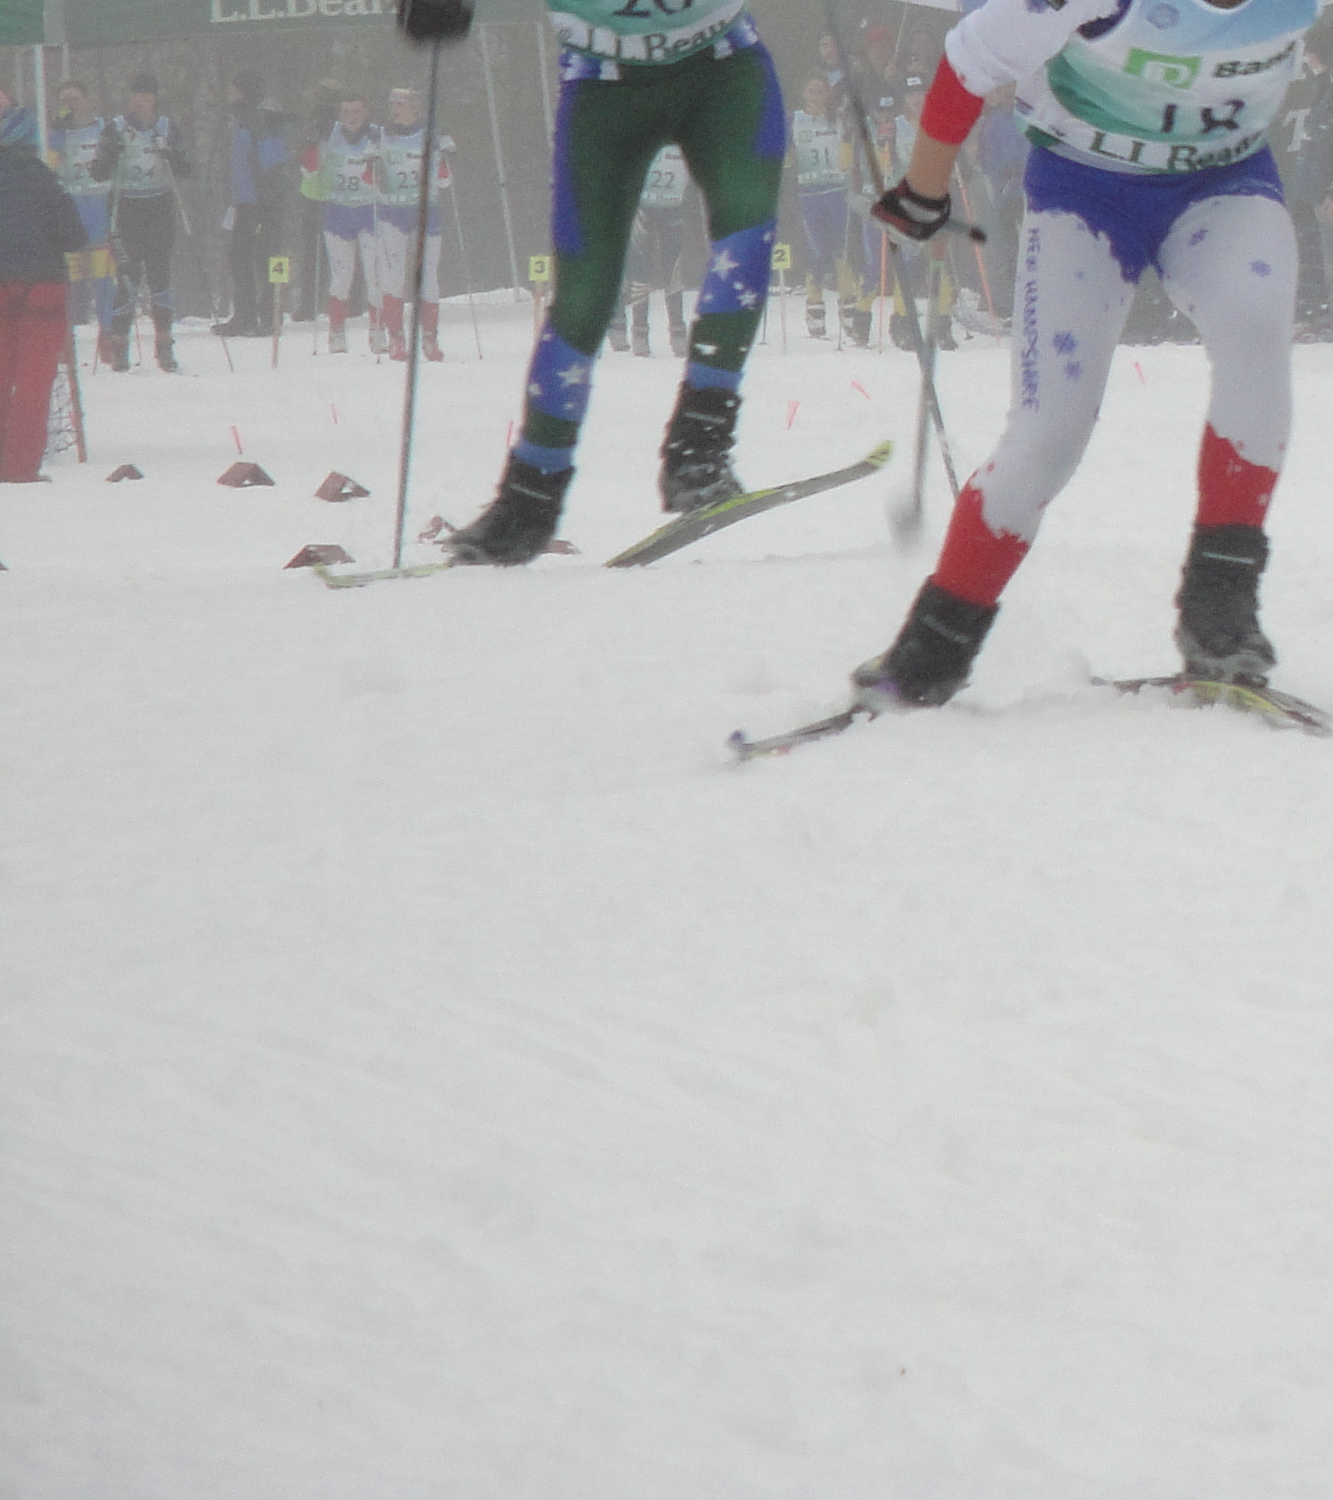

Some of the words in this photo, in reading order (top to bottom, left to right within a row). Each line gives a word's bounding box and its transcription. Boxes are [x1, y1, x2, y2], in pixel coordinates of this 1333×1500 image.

[1160, 98, 1245, 134] 18
[651, 170, 675, 189] 22
[773, 250, 786, 263] 2
[273, 262, 284, 275] 4
[534, 260, 546, 274] 3
